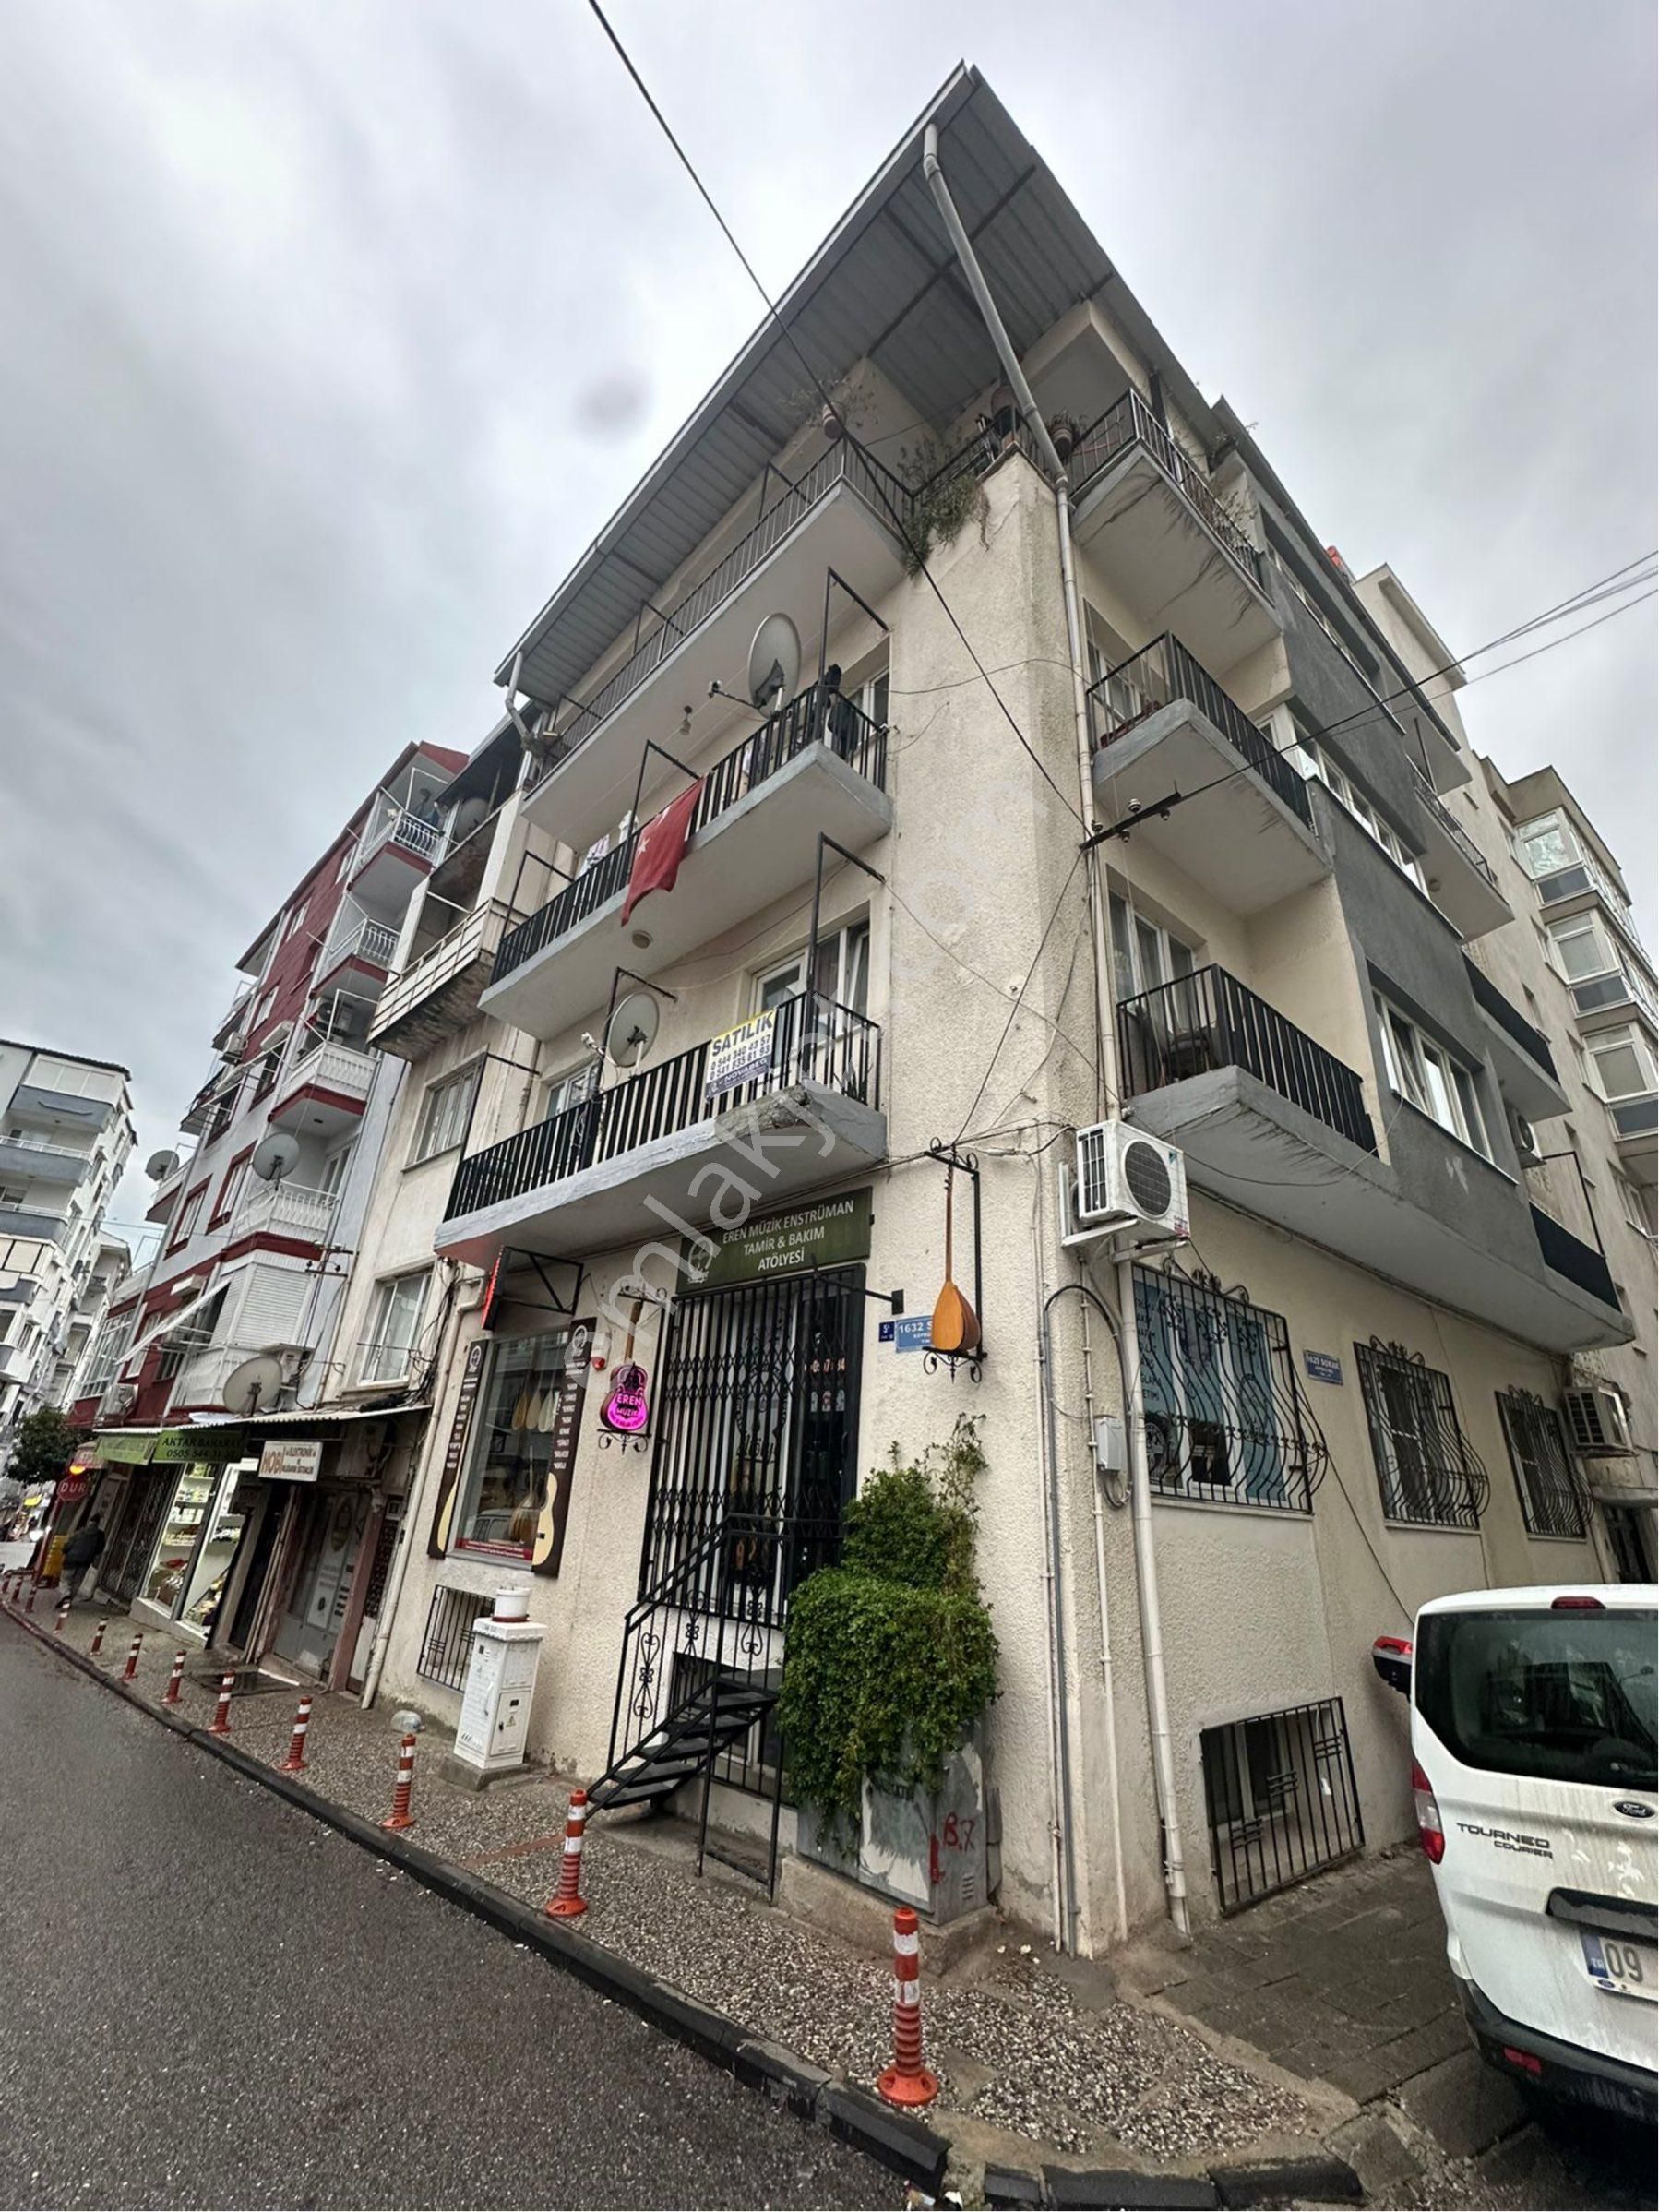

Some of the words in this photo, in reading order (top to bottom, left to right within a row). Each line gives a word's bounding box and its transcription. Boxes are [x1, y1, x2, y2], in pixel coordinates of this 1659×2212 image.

[712, 1012, 773, 1057] SATILIK
[760, 1034, 771, 1046] 57
[722, 1228, 747, 1245] EREN
[748, 1216, 782, 1238] MÜZİK
[783, 1199, 854, 1228] ENSTRÜMAN
[744, 1237, 775, 1256] TAMİR
[777, 1235, 786, 1249] &
[788, 1226, 825, 1246] BAKIM
[758, 1247, 806, 1272] ATÖLYESİ
[899, 1322, 924, 1333] 1632
[617, 1393, 643, 1407] EREN
[162, 1437, 196, 1448] AKTAR
[166, 1449, 190, 1458] 0505
[60, 1482, 88, 1492] DUR
[1456, 1822, 1551, 1849] TOURNEO
[1493, 1840, 1554, 1859] COURIER
[1591, 1957, 1605, 1969] TR
[1605, 1943, 1643, 1982] 09
